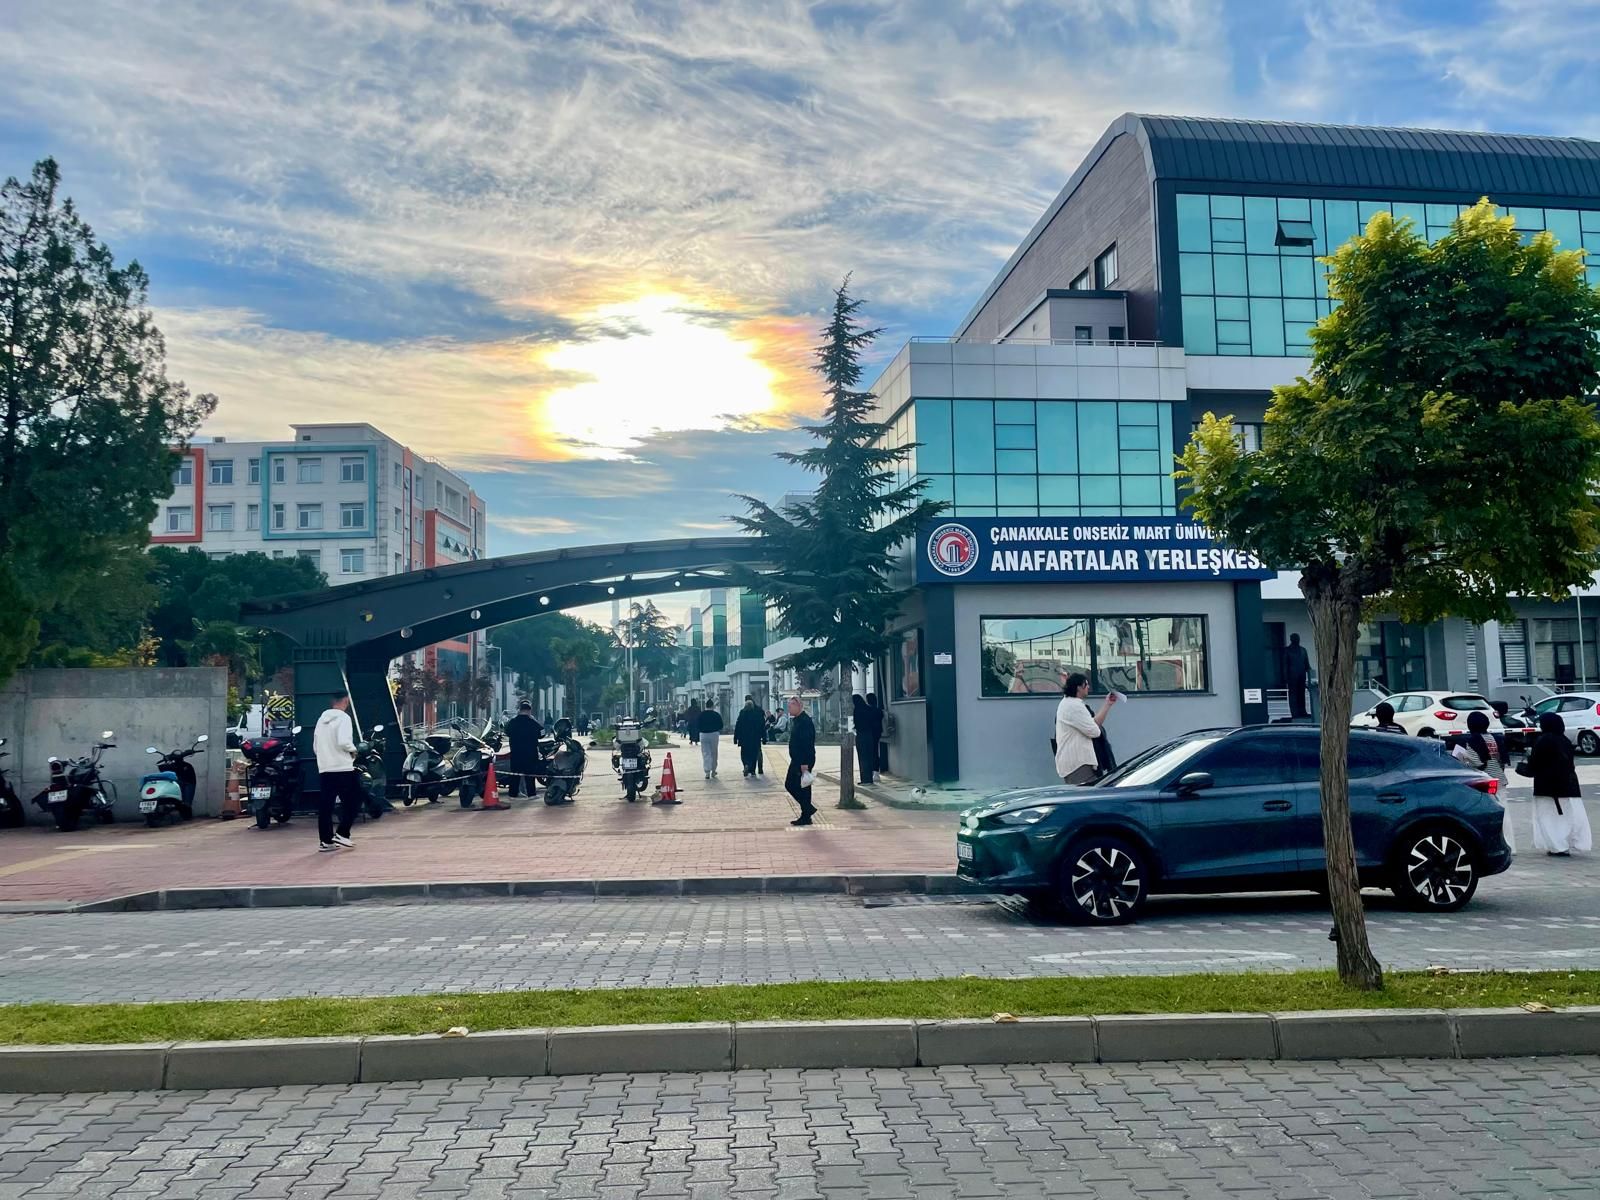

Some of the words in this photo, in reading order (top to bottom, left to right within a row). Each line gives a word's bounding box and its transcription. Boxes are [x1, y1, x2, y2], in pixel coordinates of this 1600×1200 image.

[990, 526, 1069, 545] ÇANAKKALE
[1073, 523, 1130, 541] ONSEKİZ
[1133, 525, 1171, 540] MART
[990, 549, 1140, 572] ANAFARTALAR
